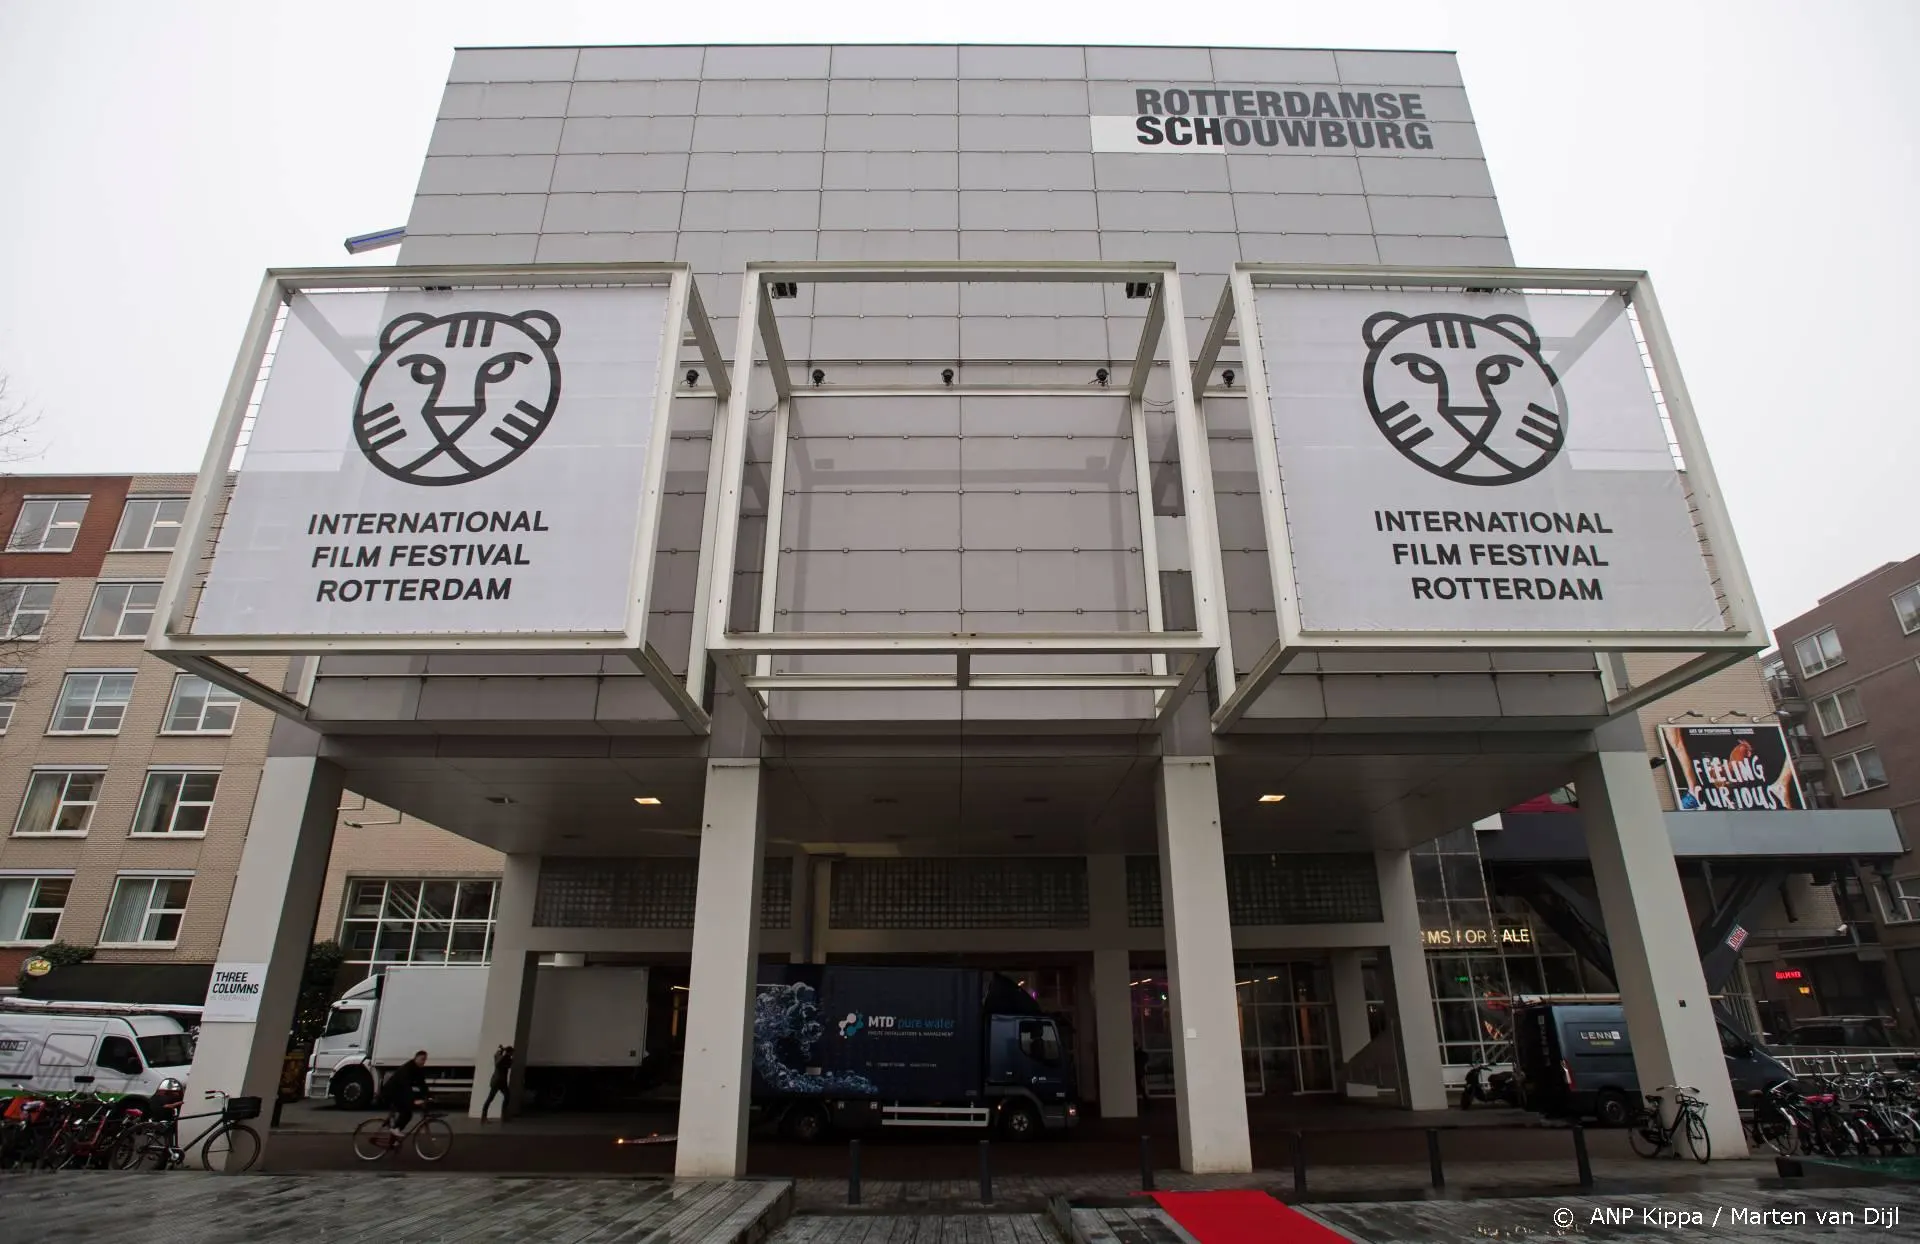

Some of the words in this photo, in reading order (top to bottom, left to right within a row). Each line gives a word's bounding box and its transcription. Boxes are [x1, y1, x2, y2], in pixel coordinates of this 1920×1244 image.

[1135, 88, 1426, 120] ROTTERDAMSE
[1135, 116, 1434, 150] SCHOUWBURG
[307, 510, 549, 535] INTERNATIONAL
[1374, 510, 1614, 534] INTERNATIONAL
[311, 545, 382, 568] FILM
[389, 543, 531, 567] FESTIVAL
[1392, 543, 1462, 566] FILM
[1469, 543, 1609, 567] FESTIVAL
[315, 577, 512, 603] ROTTERDAM
[1411, 576, 1604, 601] ROTTERDAM
[1691, 754, 1767, 786] FEELING
[1693, 783, 1778, 810] CURIOUS
[212, 983, 260, 994] COLUMNS
[216, 971, 249, 983] THREE
[868, 1016, 894, 1028] MTD
[897, 1018, 923, 1030] pure
[924, 1018, 956, 1029] water
